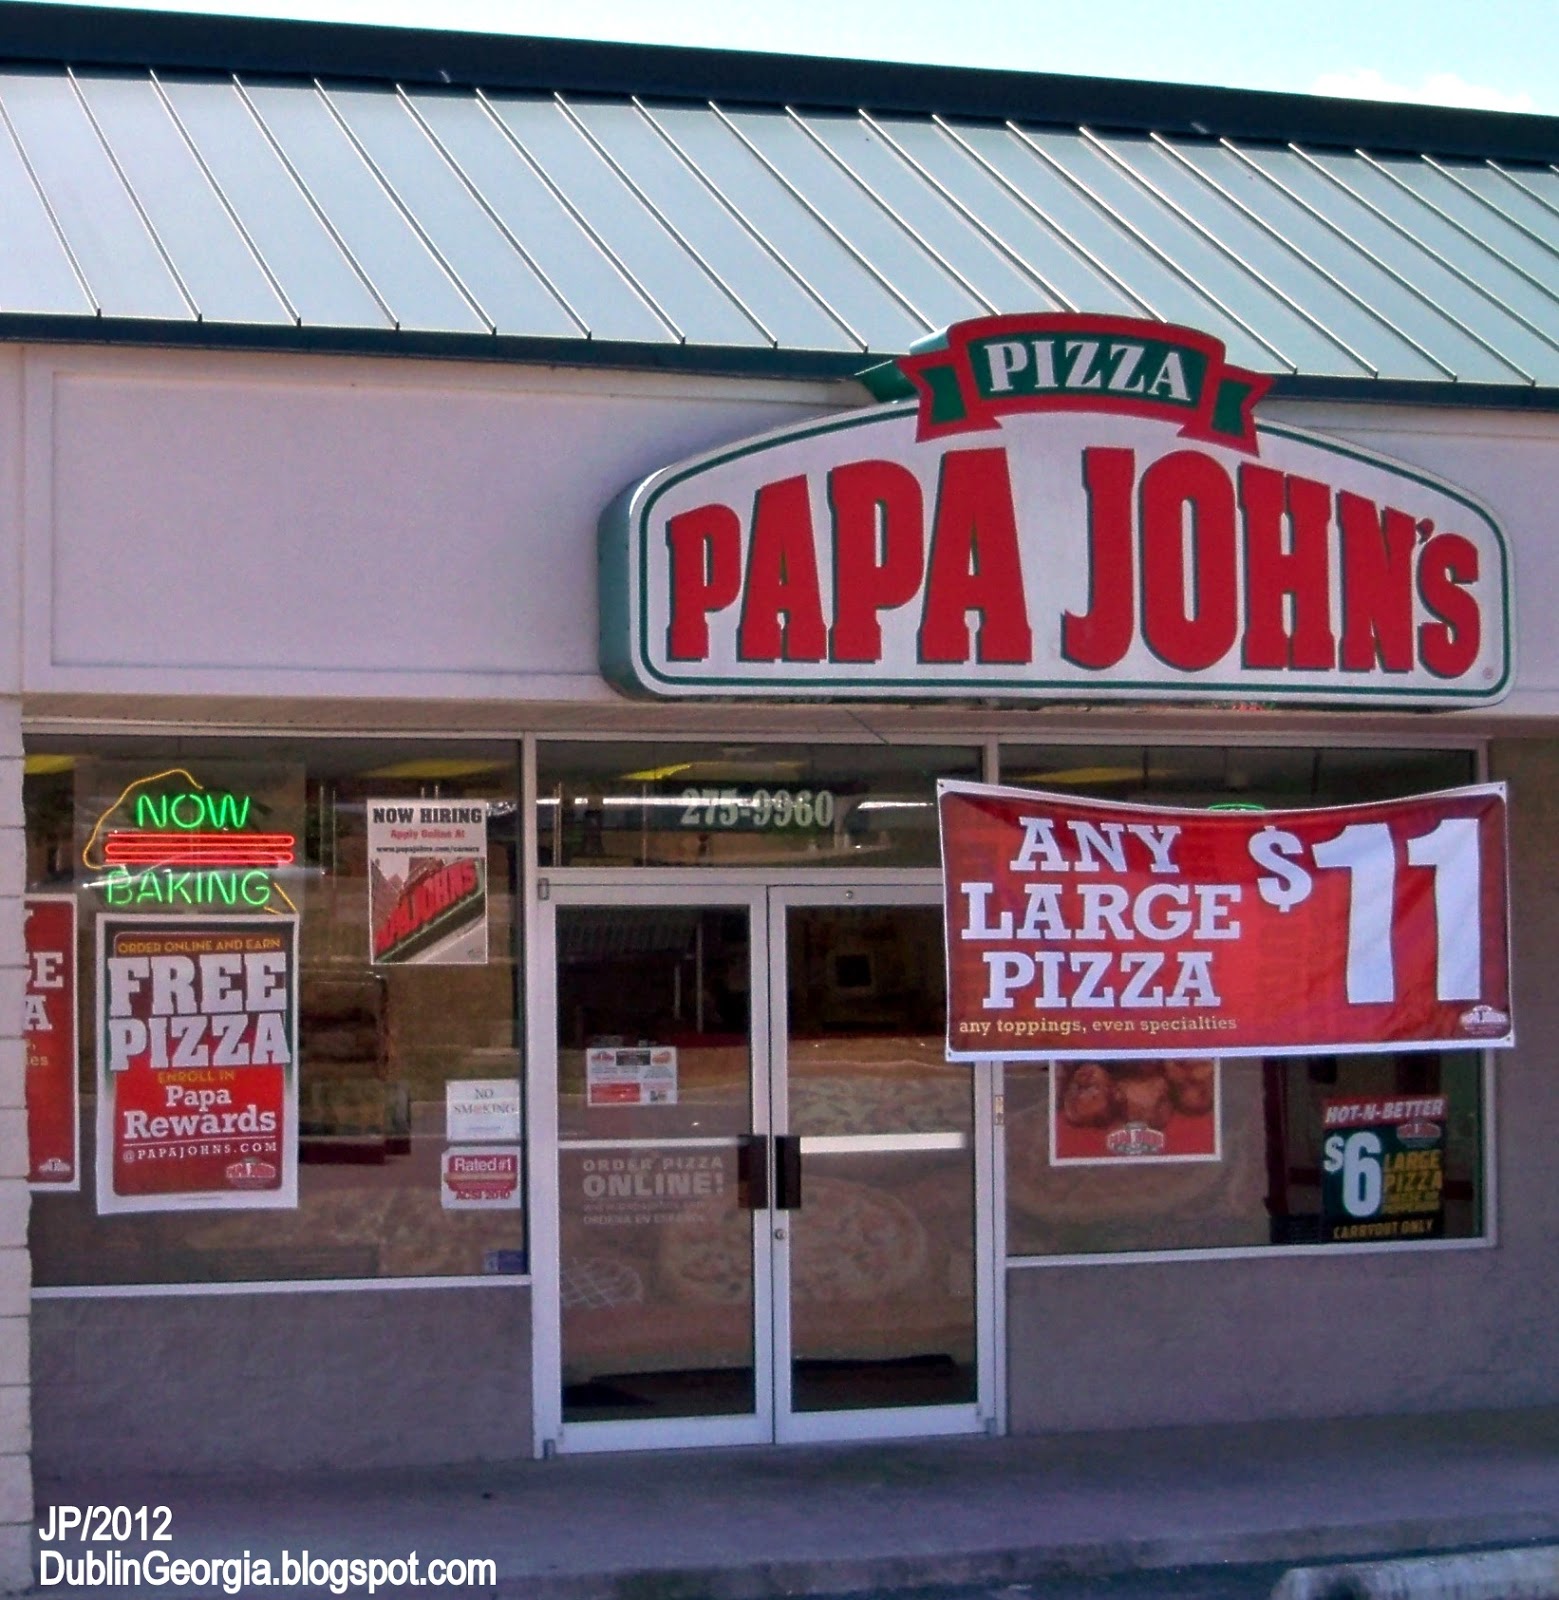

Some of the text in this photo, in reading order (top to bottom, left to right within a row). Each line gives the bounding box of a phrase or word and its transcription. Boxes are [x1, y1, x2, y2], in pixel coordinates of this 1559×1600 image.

[983, 339, 1193, 402] PIZZA
[665, 445, 1480, 679] PAPA JOHN'S
[137, 793, 250, 829] NOW
[373, 807, 482, 824] NOW HIRING
[680, 787, 835, 828] 275-9960
[1009, 816, 1182, 874] ANY
[106, 869, 271, 905] BAKING
[960, 882, 1242, 941] LARGE
[1248, 818, 1481, 1005] $11
[118, 938, 281, 954] ORDER ONLINE AND EARN
[108, 952, 287, 1017] FREE
[982, 951, 1221, 1009] PIZZA
[109, 1013, 291, 1071] PIZZA
[959, 1015, 1237, 1035] any toppings, even specialties
[158, 1070, 236, 1083] ENROLL IN
[475, 1088, 494, 1099] NO
[165, 1085, 232, 1112] Papa
[123, 1104, 276, 1139] Rewards
[455, 1157, 497, 1171] Rated
[583, 1155, 724, 1173] ORDER PIZZA
[1384, 1170, 1443, 1193] PIZZA
[583, 1170, 724, 1198] ONLINE!
